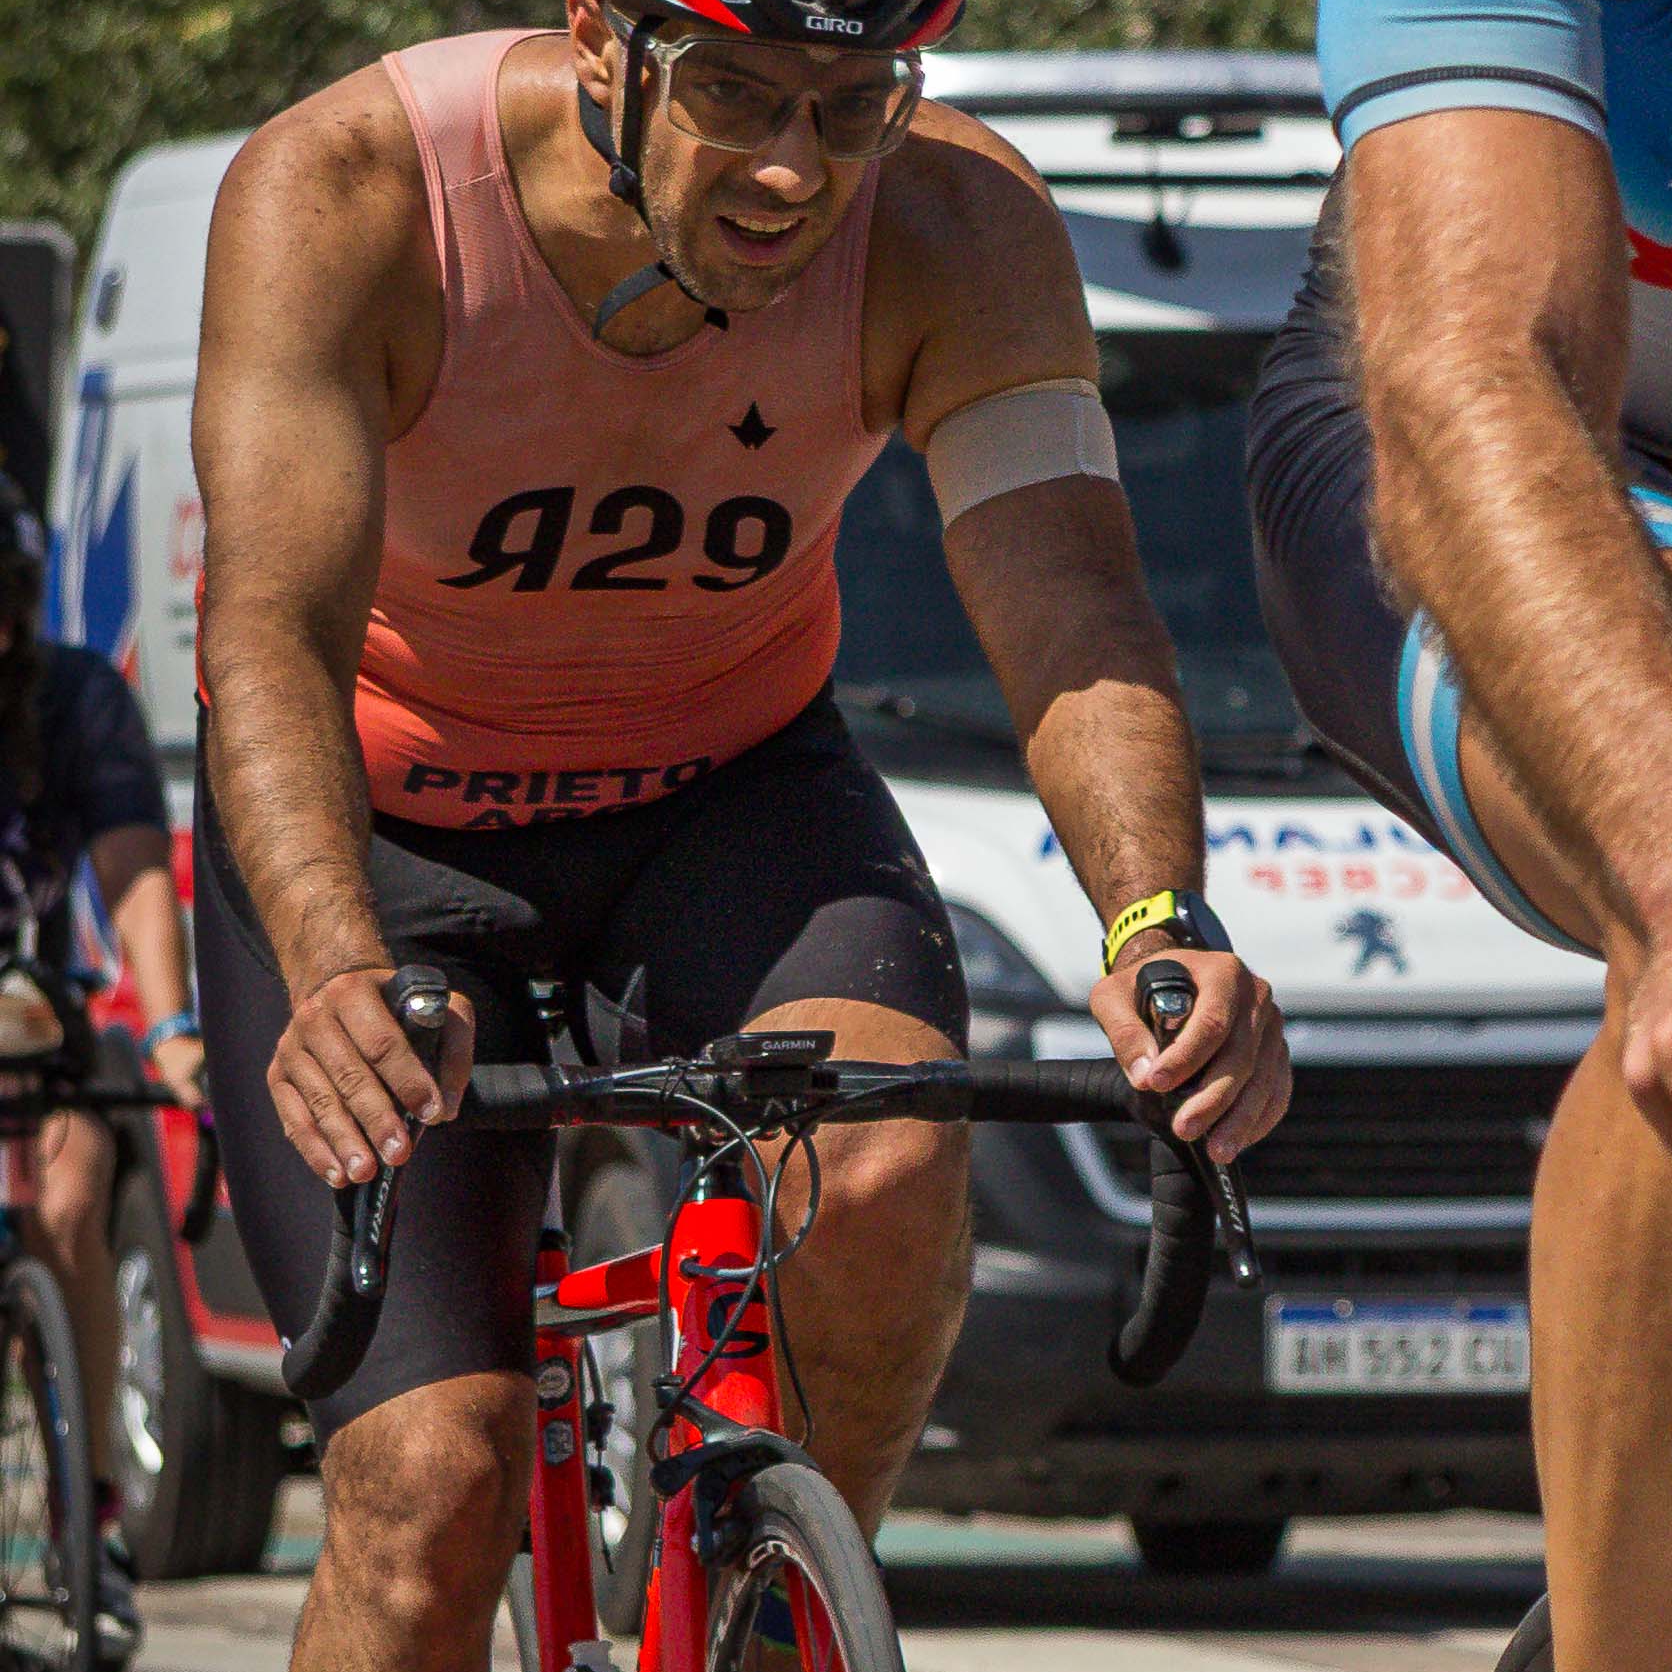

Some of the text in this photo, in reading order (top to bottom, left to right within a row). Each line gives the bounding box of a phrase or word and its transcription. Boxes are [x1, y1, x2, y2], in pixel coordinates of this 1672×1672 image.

[806, 16, 863, 35] GIRO
[402, 756, 711, 805] PRIETO
[762, 1039, 816, 1050] GARMIN
